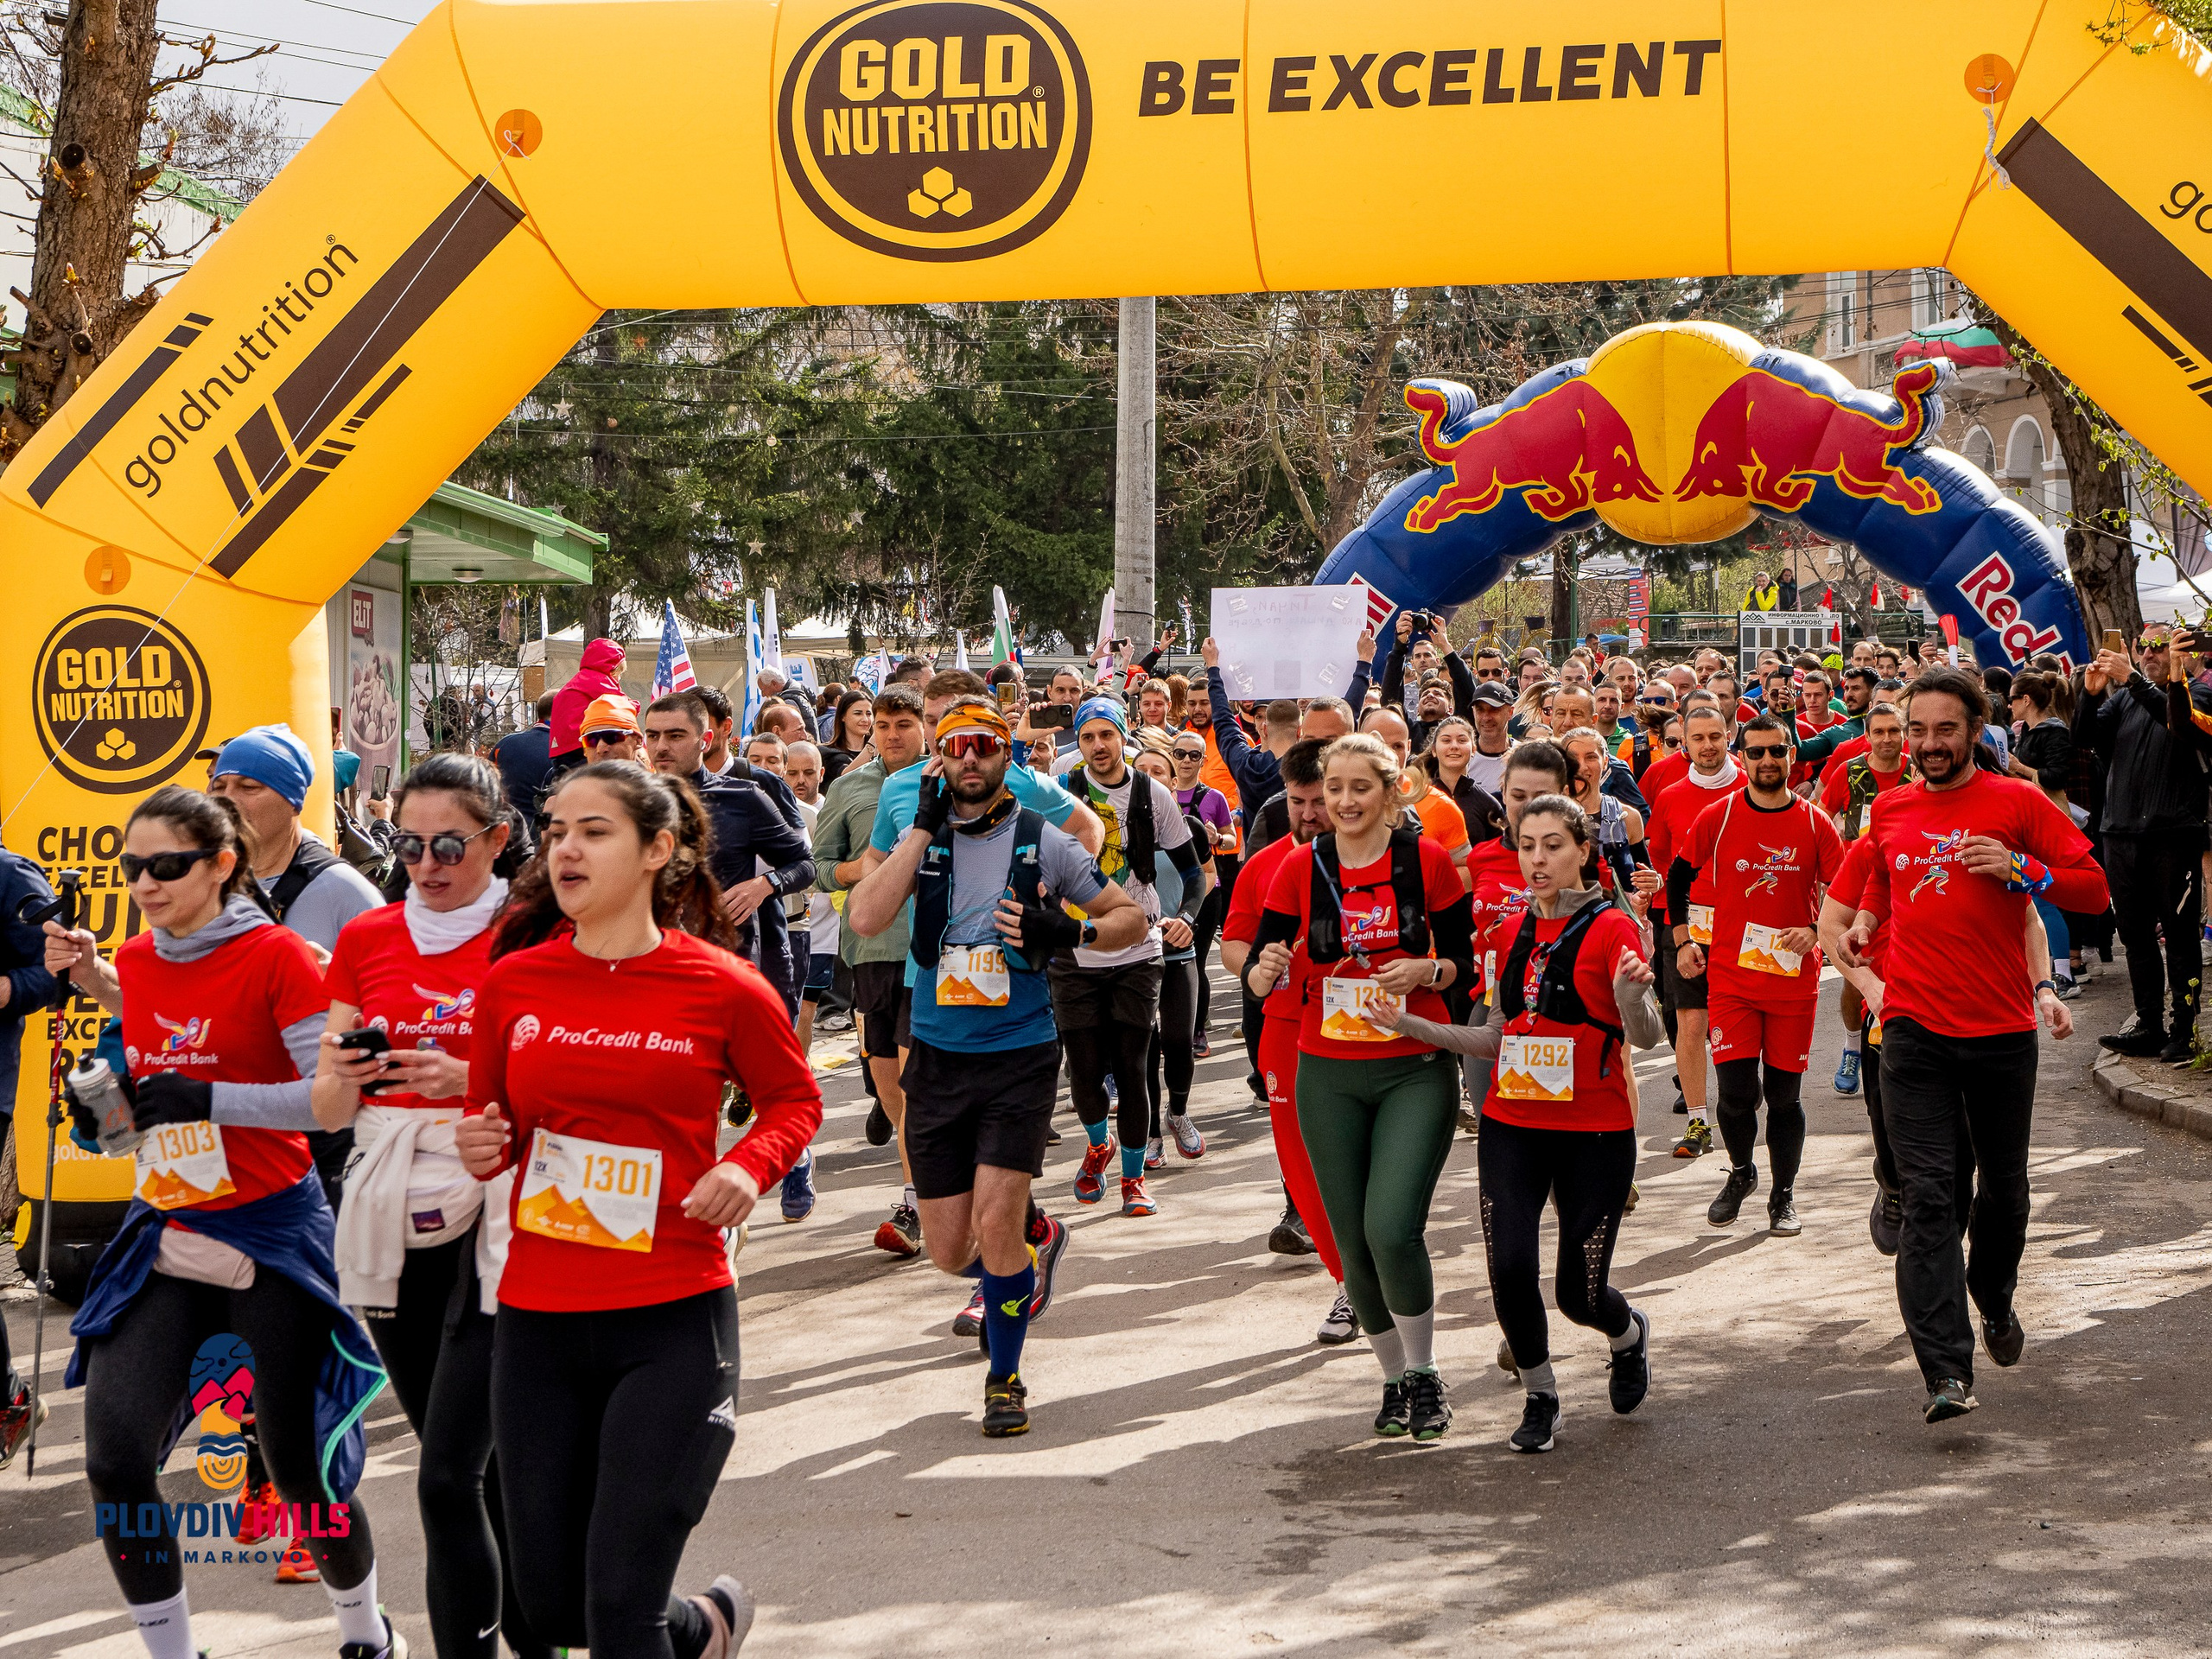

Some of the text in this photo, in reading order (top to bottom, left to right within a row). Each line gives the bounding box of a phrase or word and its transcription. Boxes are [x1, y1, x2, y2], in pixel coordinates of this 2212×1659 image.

[839, 33, 1031, 102] GOLD
[1138, 39, 1722, 118] BE EXCELLENT
[823, 101, 1048, 157] NUTRITION
[125, 243, 359, 499] goldnutrition
[1958, 553, 2061, 664] Red
[57, 645, 172, 690] GOLD
[51, 690, 184, 722] NUTRITION
[1752, 863, 1783, 872] ProCredit
[1914, 854, 1953, 865] ProCredit
[1485, 903, 1521, 912] ProCredit
[1376, 929, 1399, 938] Bank
[968, 951, 1006, 975] 1199
[395, 1020, 456, 1035] ProCredit
[547, 1026, 694, 1055] ProCredit Bank
[143, 1052, 219, 1065] ProCredit Bank
[1522, 1043, 1569, 1067] 1292
[156, 1120, 216, 1162] 1303
[582, 1154, 653, 1198] 1301
